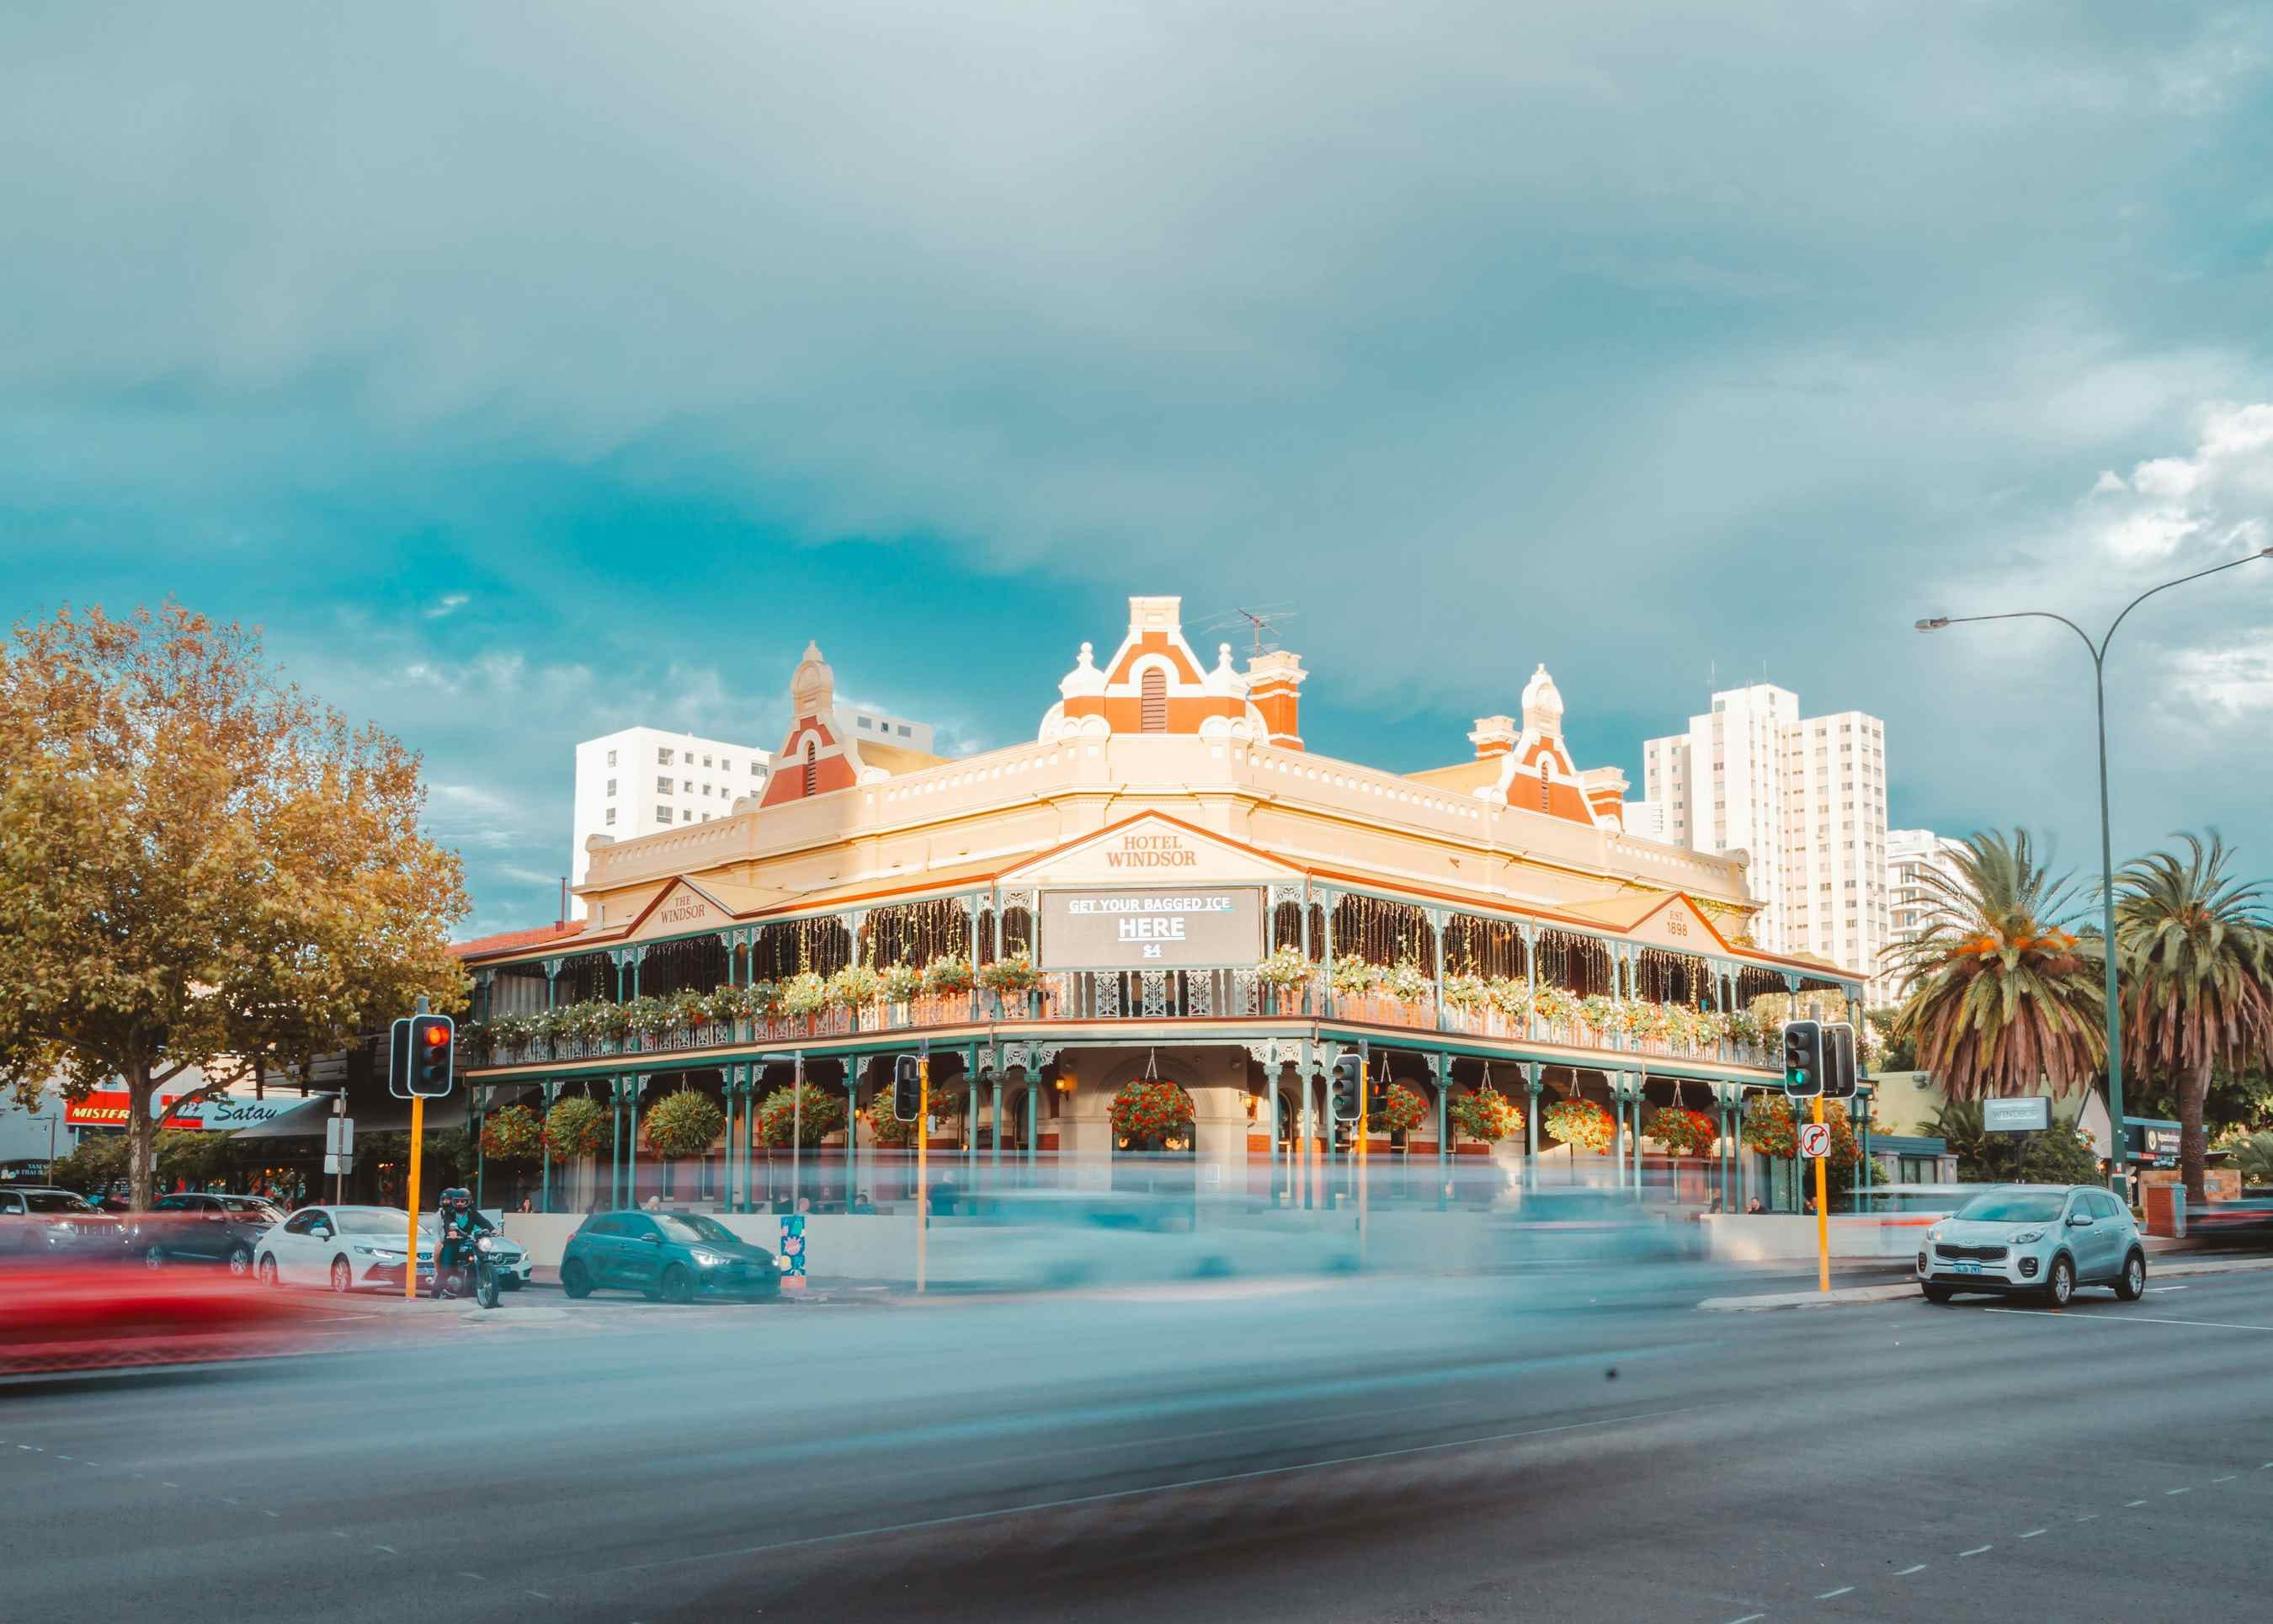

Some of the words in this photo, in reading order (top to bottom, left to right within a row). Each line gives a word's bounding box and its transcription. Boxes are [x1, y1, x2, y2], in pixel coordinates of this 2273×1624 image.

[1124, 836, 1182, 849] HOTEL
[1106, 851, 1196, 867] WINDSOR
[675, 896, 691, 907] THE
[1069, 900, 1096, 912] GET
[1100, 899, 1140, 911] YOUR
[1144, 897, 1202, 910] BAGGED
[1206, 897, 1231, 909] ICE
[661, 904, 705, 923] WINDSOR
[1119, 917, 1185, 938] HERE
[1667, 922, 1688, 936] 1898
[1142, 944, 1162, 957] $4
